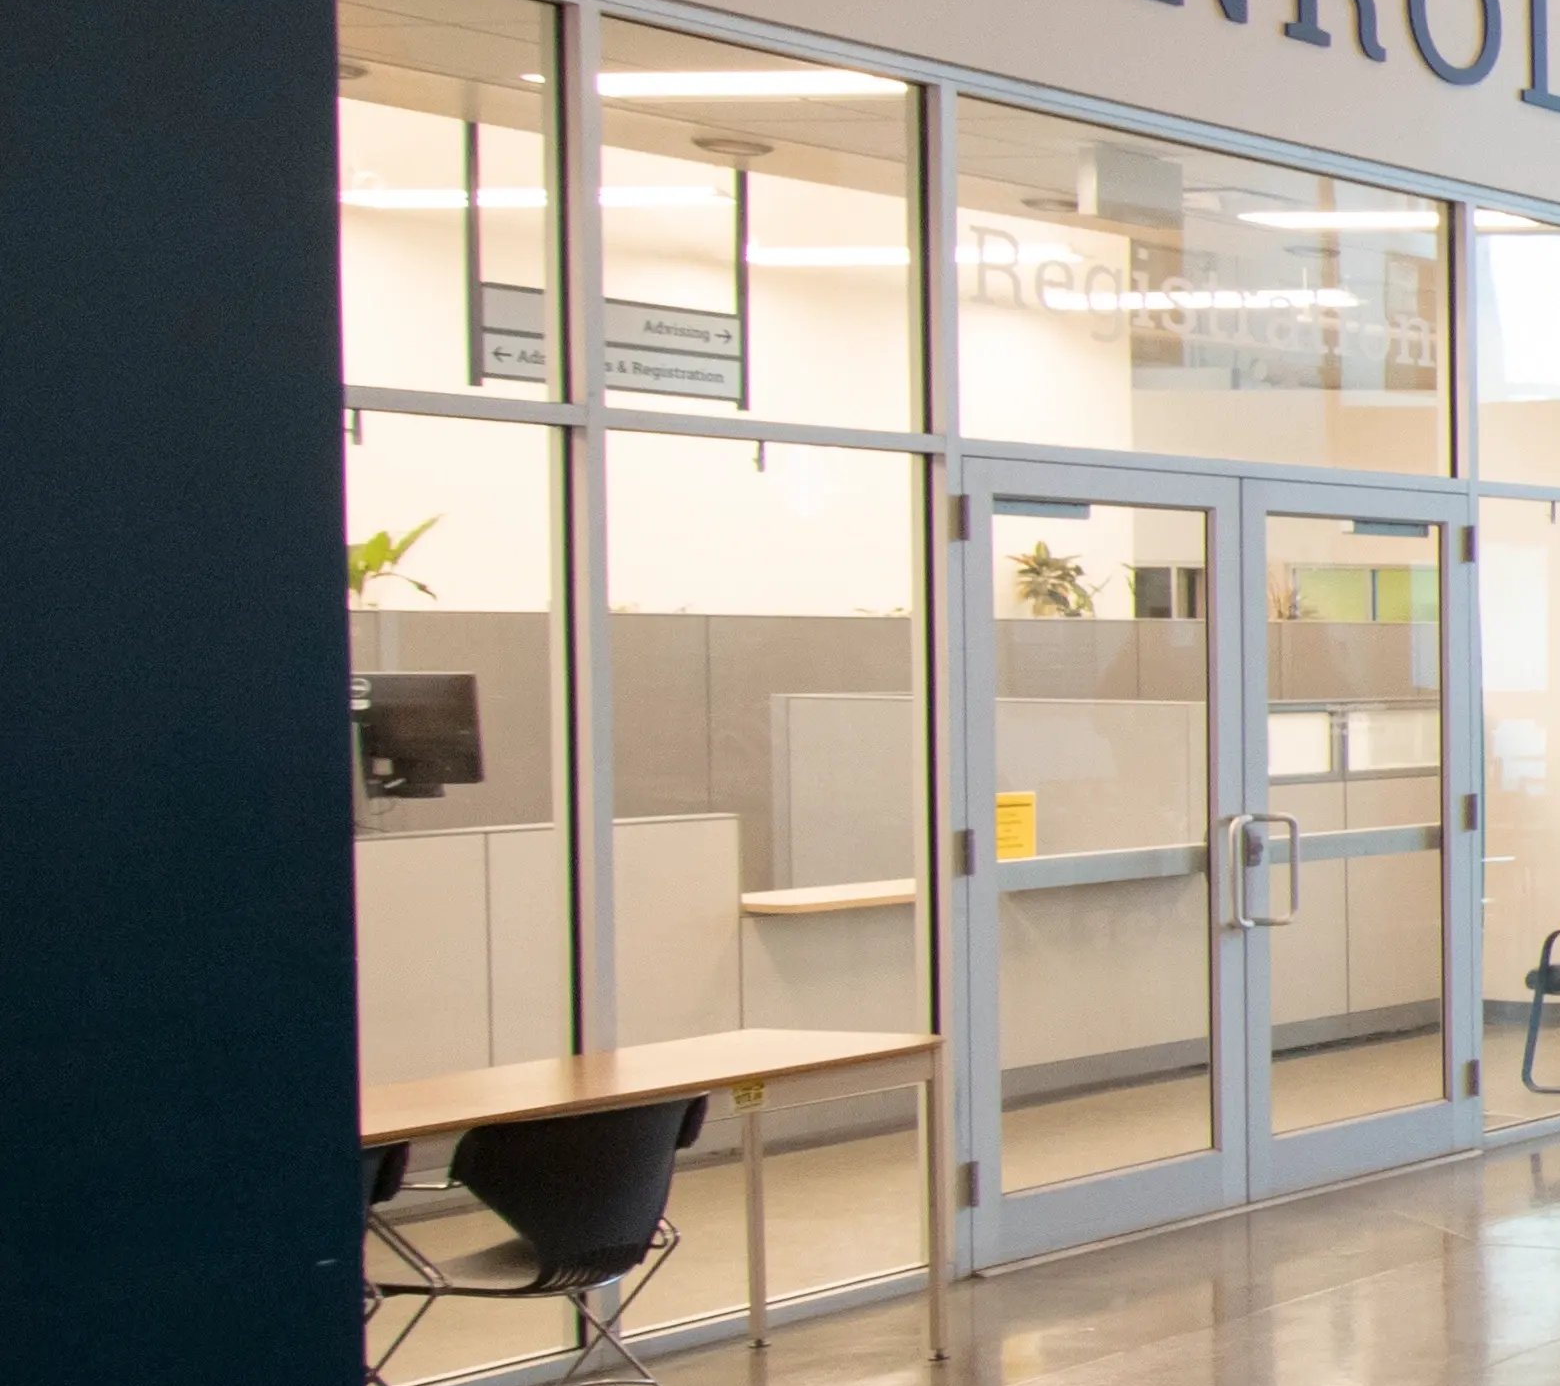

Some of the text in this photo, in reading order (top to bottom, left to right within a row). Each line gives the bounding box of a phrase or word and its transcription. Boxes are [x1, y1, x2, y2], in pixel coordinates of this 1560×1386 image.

[969, 224, 1438, 368] Registration
[643, 320, 711, 343] Advising
[617, 361, 628, 374] &
[632, 361, 725, 384] Registration
